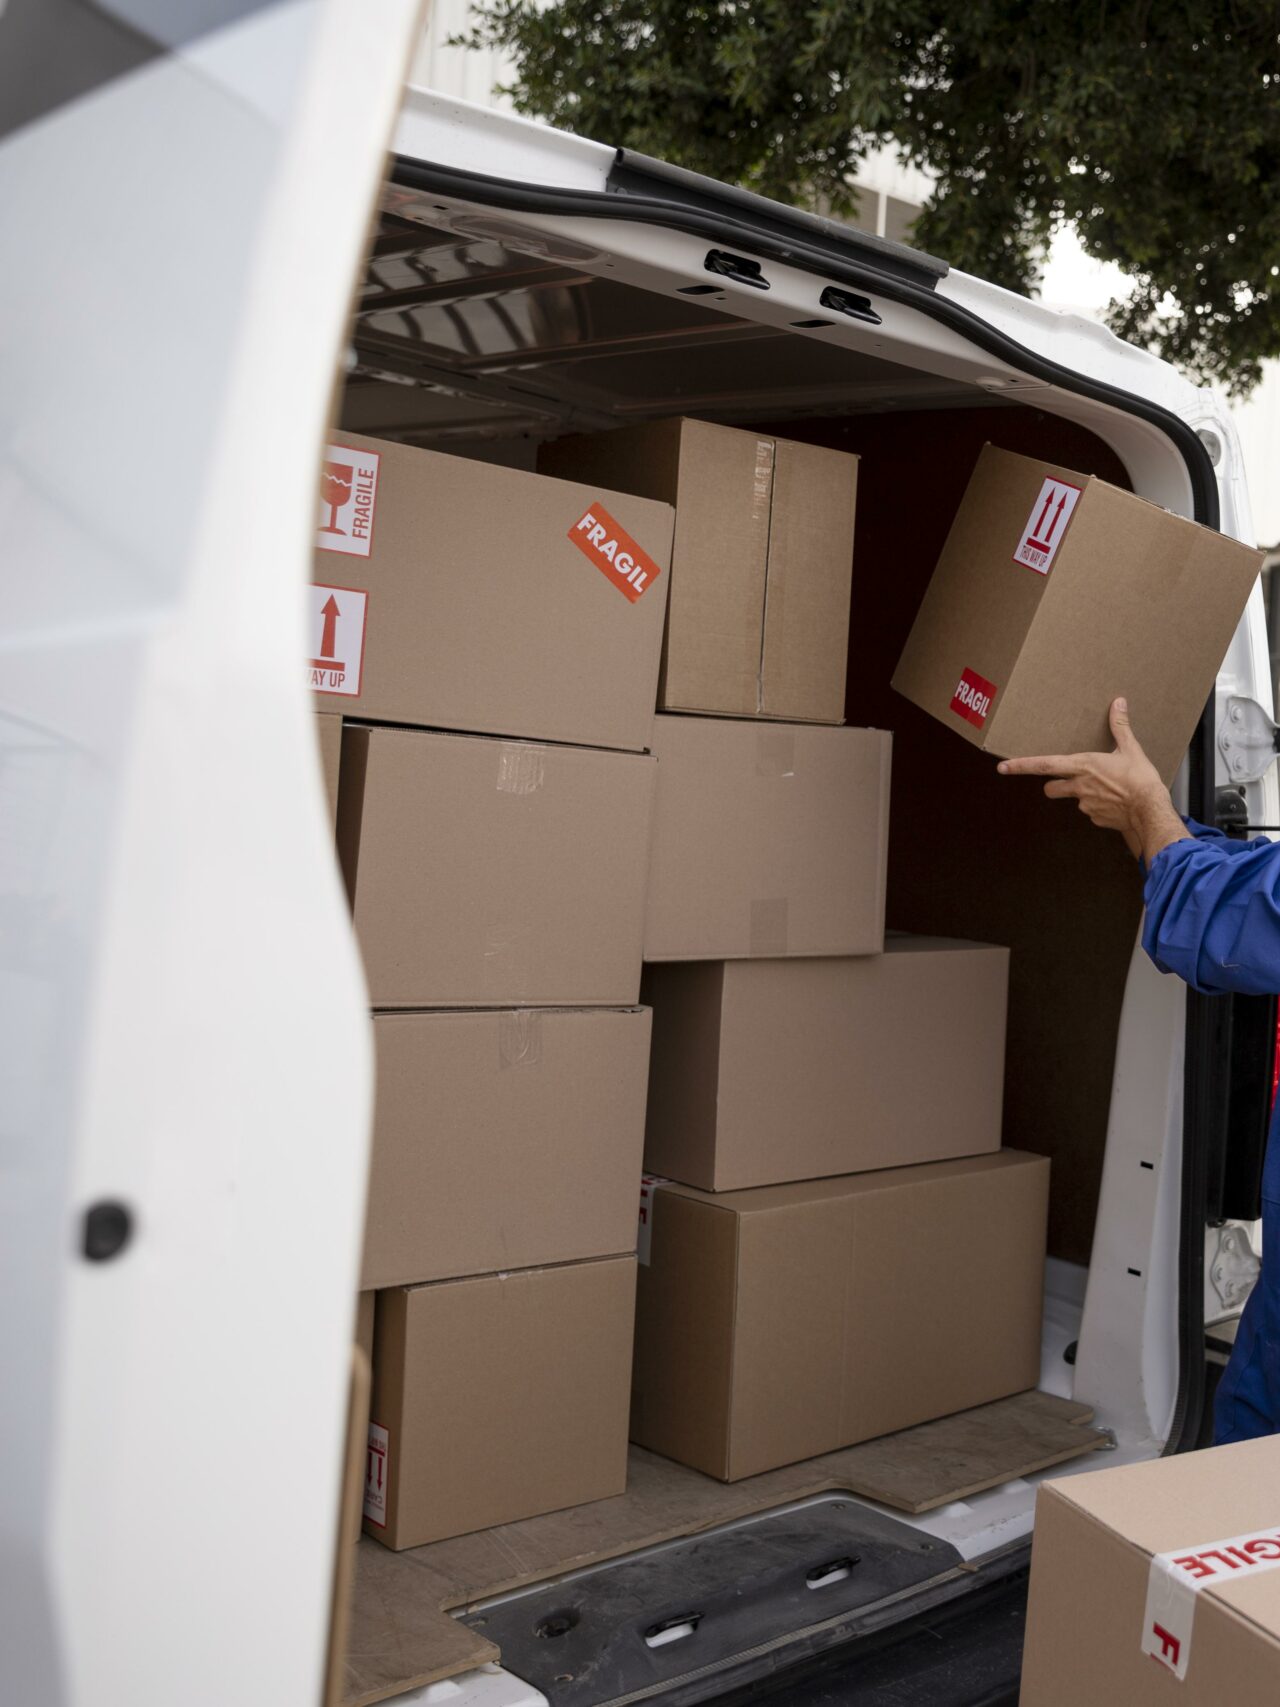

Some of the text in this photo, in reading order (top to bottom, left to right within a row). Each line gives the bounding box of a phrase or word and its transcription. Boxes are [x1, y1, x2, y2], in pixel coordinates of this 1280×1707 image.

[352, 468, 374, 539] FRAGILE
[576, 512, 648, 593] FRAGIL
[305, 669, 346, 688] AY UP
[954, 679, 990, 718] FRAGIL
